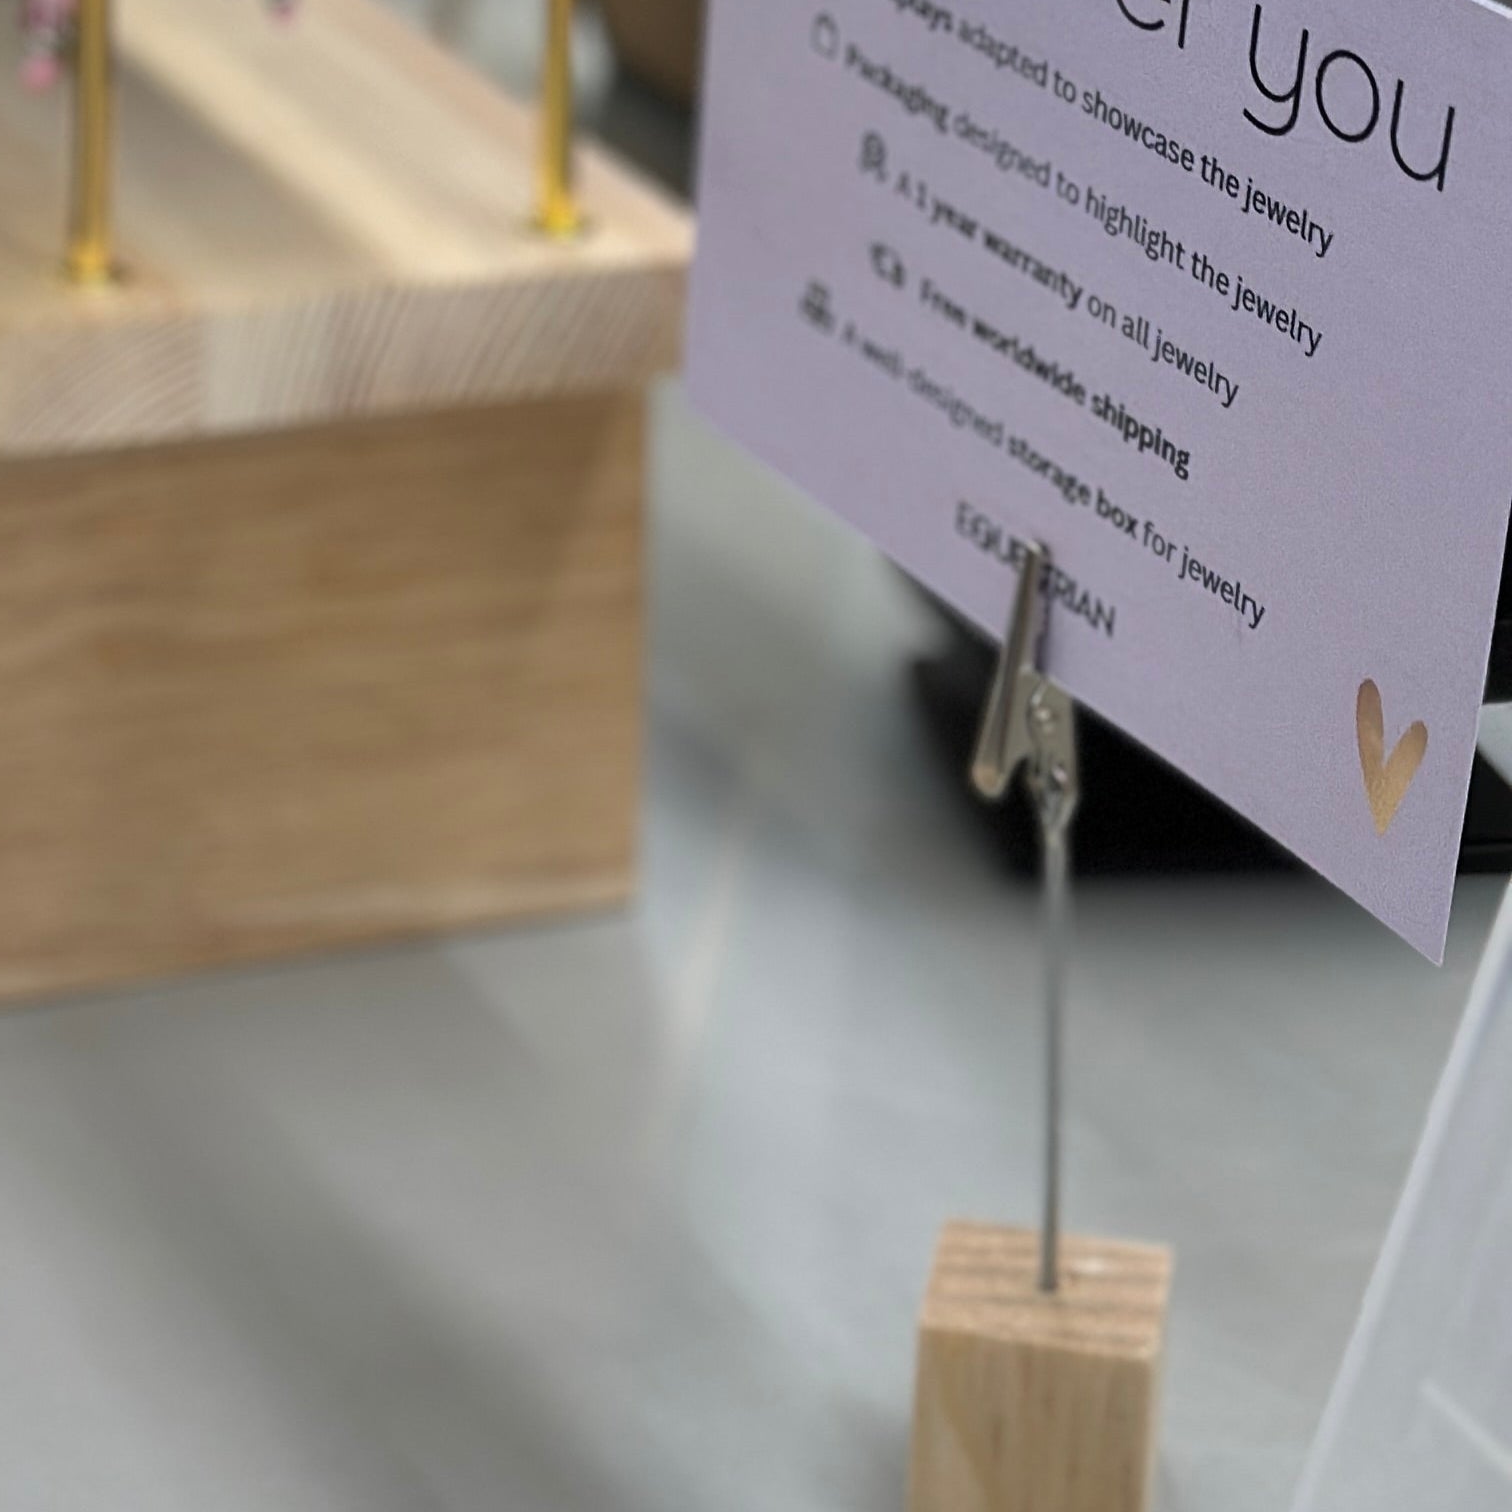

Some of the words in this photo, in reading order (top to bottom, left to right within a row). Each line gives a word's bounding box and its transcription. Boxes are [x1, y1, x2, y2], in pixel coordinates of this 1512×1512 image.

[958, 19, 1049, 89] adapted
[1054, 70, 1077, 105] to
[1081, 88, 1195, 172] showcase
[1201, 153, 1240, 198] the
[1241, 178, 1334, 258] jewelry
[1243, 3, 1457, 192] you
[930, 196, 979, 241] year
[983, 229, 1083, 310] warranty
[1087, 293, 1117, 330] on
[1121, 314, 1151, 351] all
[1151, 329, 1240, 409] jewelry
[953, 113, 1051, 188] designed
[1056, 171, 1081, 206] to
[1085, 185, 1187, 271] highlight
[1191, 251, 1231, 296] the
[1231, 275, 1324, 358] jewelry
[971, 316, 1087, 408] worldwide
[1090, 391, 1191, 481] shipping
[1007, 434, 1092, 506] storage
[1095, 488, 1139, 541] box
[1141, 520, 1178, 563] for
[1177, 546, 1266, 630] jewelry
